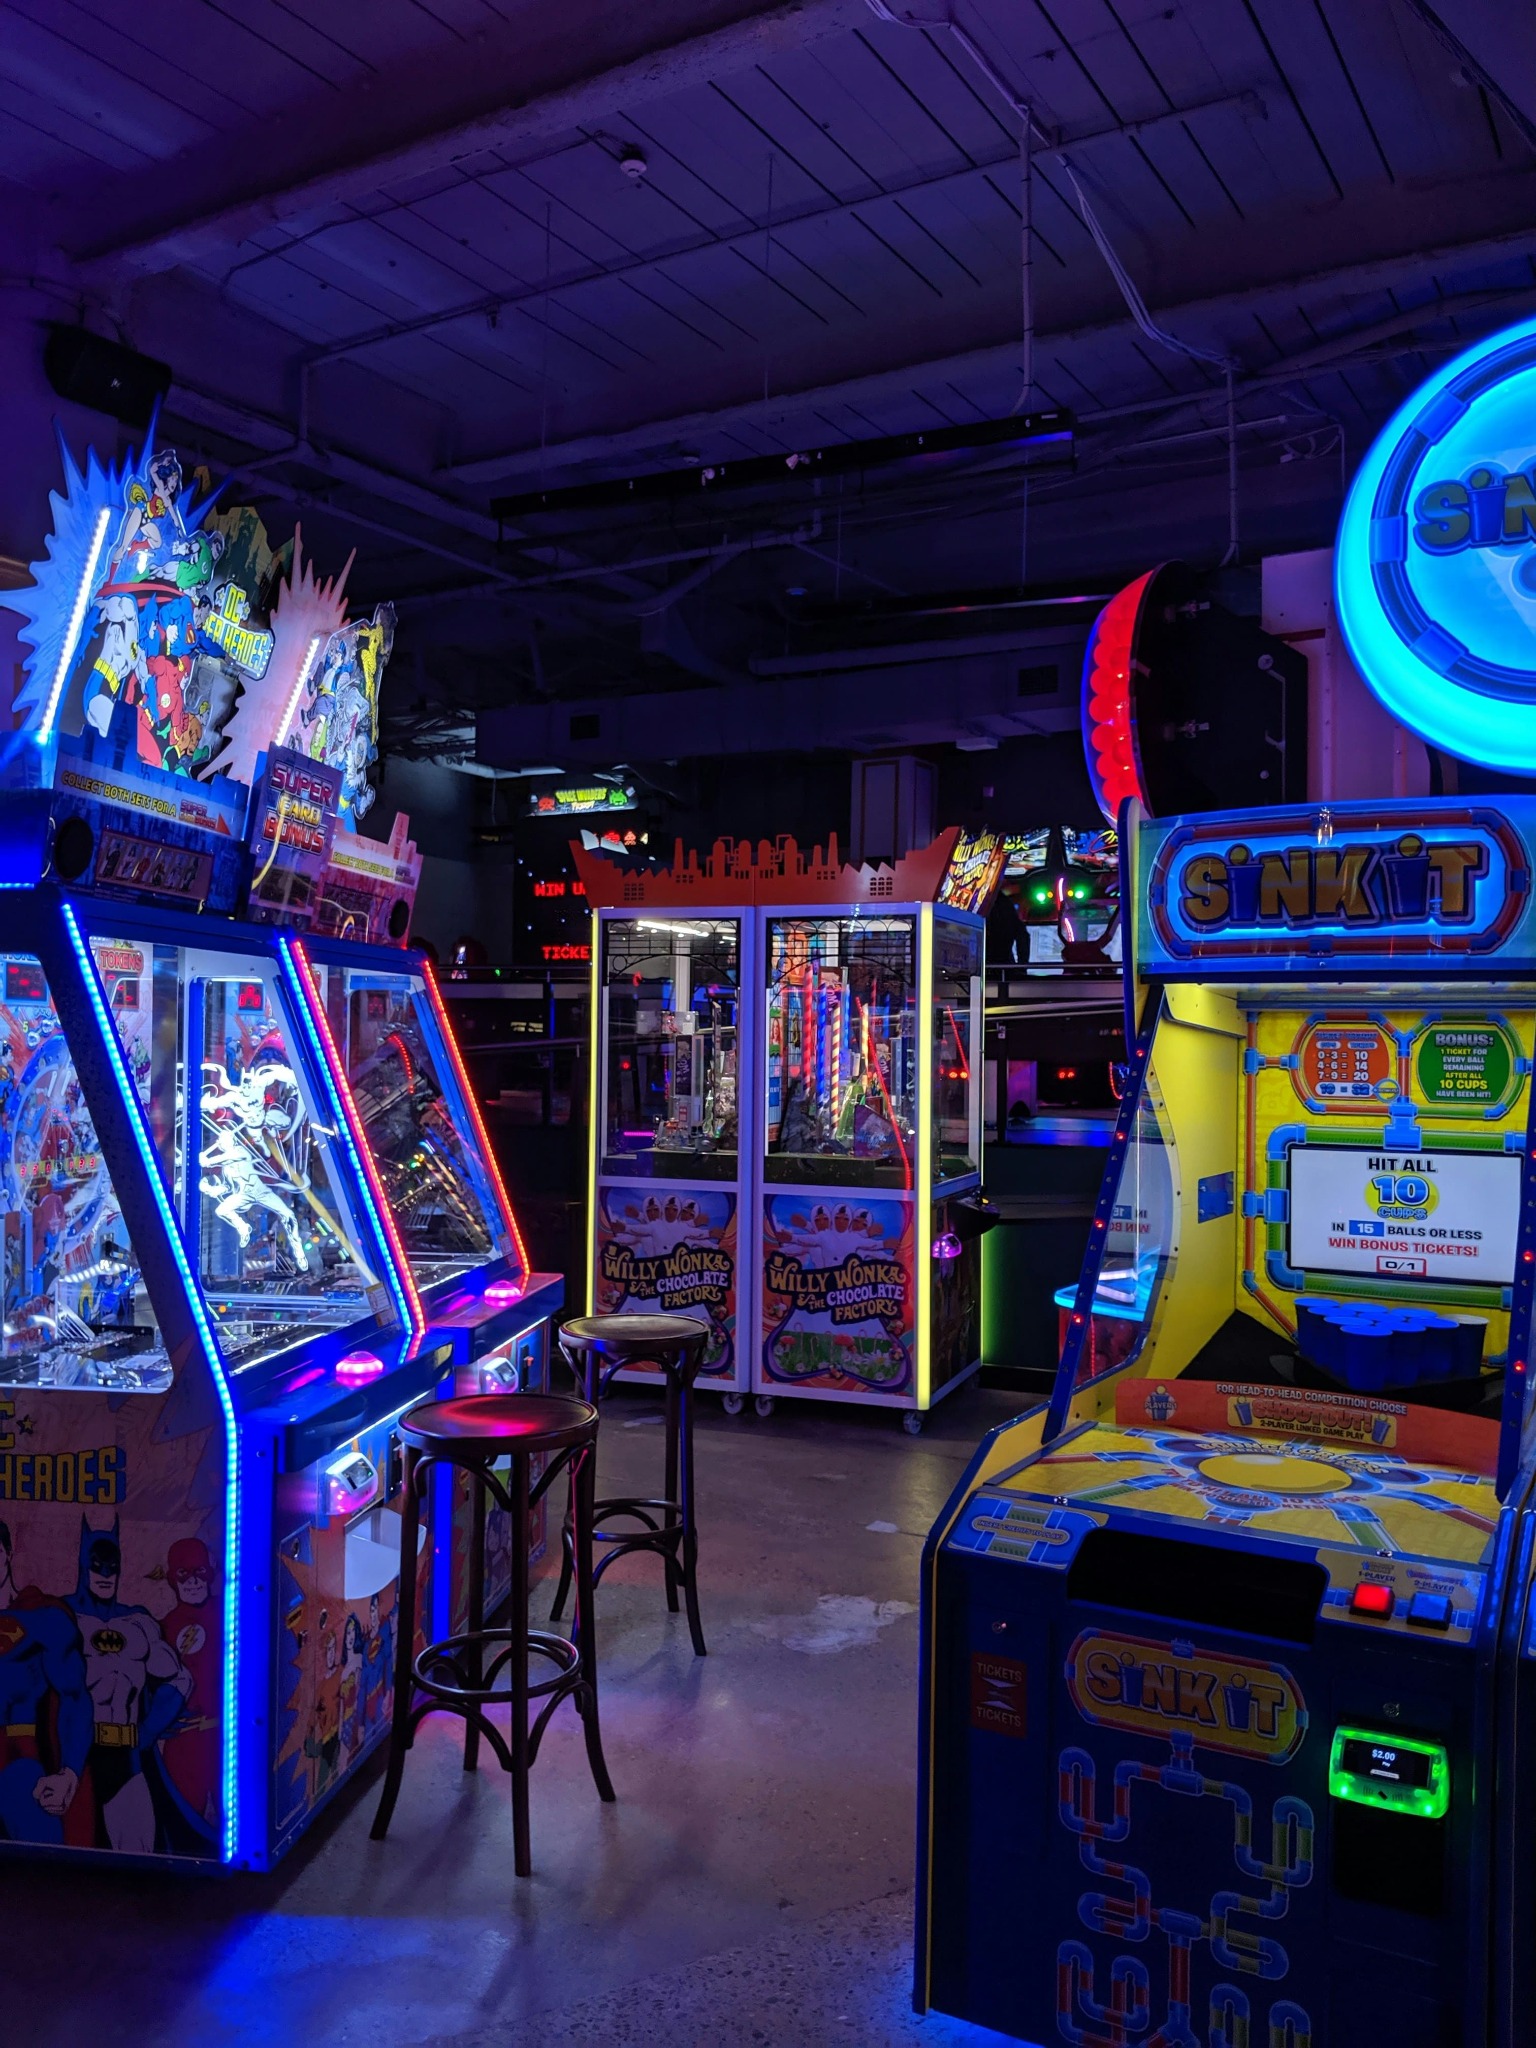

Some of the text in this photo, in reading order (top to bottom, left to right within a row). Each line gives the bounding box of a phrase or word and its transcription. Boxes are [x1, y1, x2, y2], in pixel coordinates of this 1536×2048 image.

[224, 586, 246, 623] DC
[223, 623, 269, 671] HEROES
[61, 770, 177, 818] COLLECT BOTH SETS FOR A
[270, 761, 335, 809] SUPER
[263, 807, 328, 855] BONUS
[534, 883, 564, 897] WIN
[101, 951, 142, 970] TOKENS
[543, 946, 592, 960] TICKE
[1435, 1033, 1494, 1046] BONUS:
[1354, 1051, 1368, 1060] 10
[1354, 1061, 1368, 1070] 14
[1353, 1071, 1369, 1081] 20
[1440, 1080, 1488, 1089] 10 CUPS
[1368, 1158, 1437, 1172] HIT ALL
[1372, 1175, 1430, 1206] 10
[1377, 1206, 1427, 1220] CUPS
[1332, 1222, 1483, 1240] IN 15 BALLS OR LESS
[1328, 1237, 1479, 1256] WIN BONUS TICKETS!
[604, 1247, 731, 1281] WILLY WONKA
[1385, 1261, 1415, 1271] 0/1
[641, 1286, 656, 1297] THE
[656, 1271, 728, 1293] CHOCOLATE
[770, 1258, 907, 1293] WILLY WONKA
[664, 1286, 722, 1306] FACTORY
[809, 1298, 826, 1310] THE
[827, 1286, 904, 1307] CHOCOLATE
[835, 1299, 898, 1322] FACTORY
[1144, 1401, 1171, 1410] PLAYER
[1216, 1384, 1408, 1415] FOR HEAD-TO-HEAD COMPETITION CHOOSE
[1251, 1398, 1373, 1434] SHOOTOUT!
[1260, 1419, 1365, 1441] 2-PLAYER LINKED GAME PLAY
[0, 1446, 120, 1504] HEROES
[1358, 1571, 1396, 1582] 1-PLAYER
[1414, 1580, 1455, 1592] 2-PLAYER
[976, 1661, 1022, 1682] TICKETS
[976, 1705, 1021, 1727] TICKETS
[1371, 1749, 1396, 1762] $2.00
